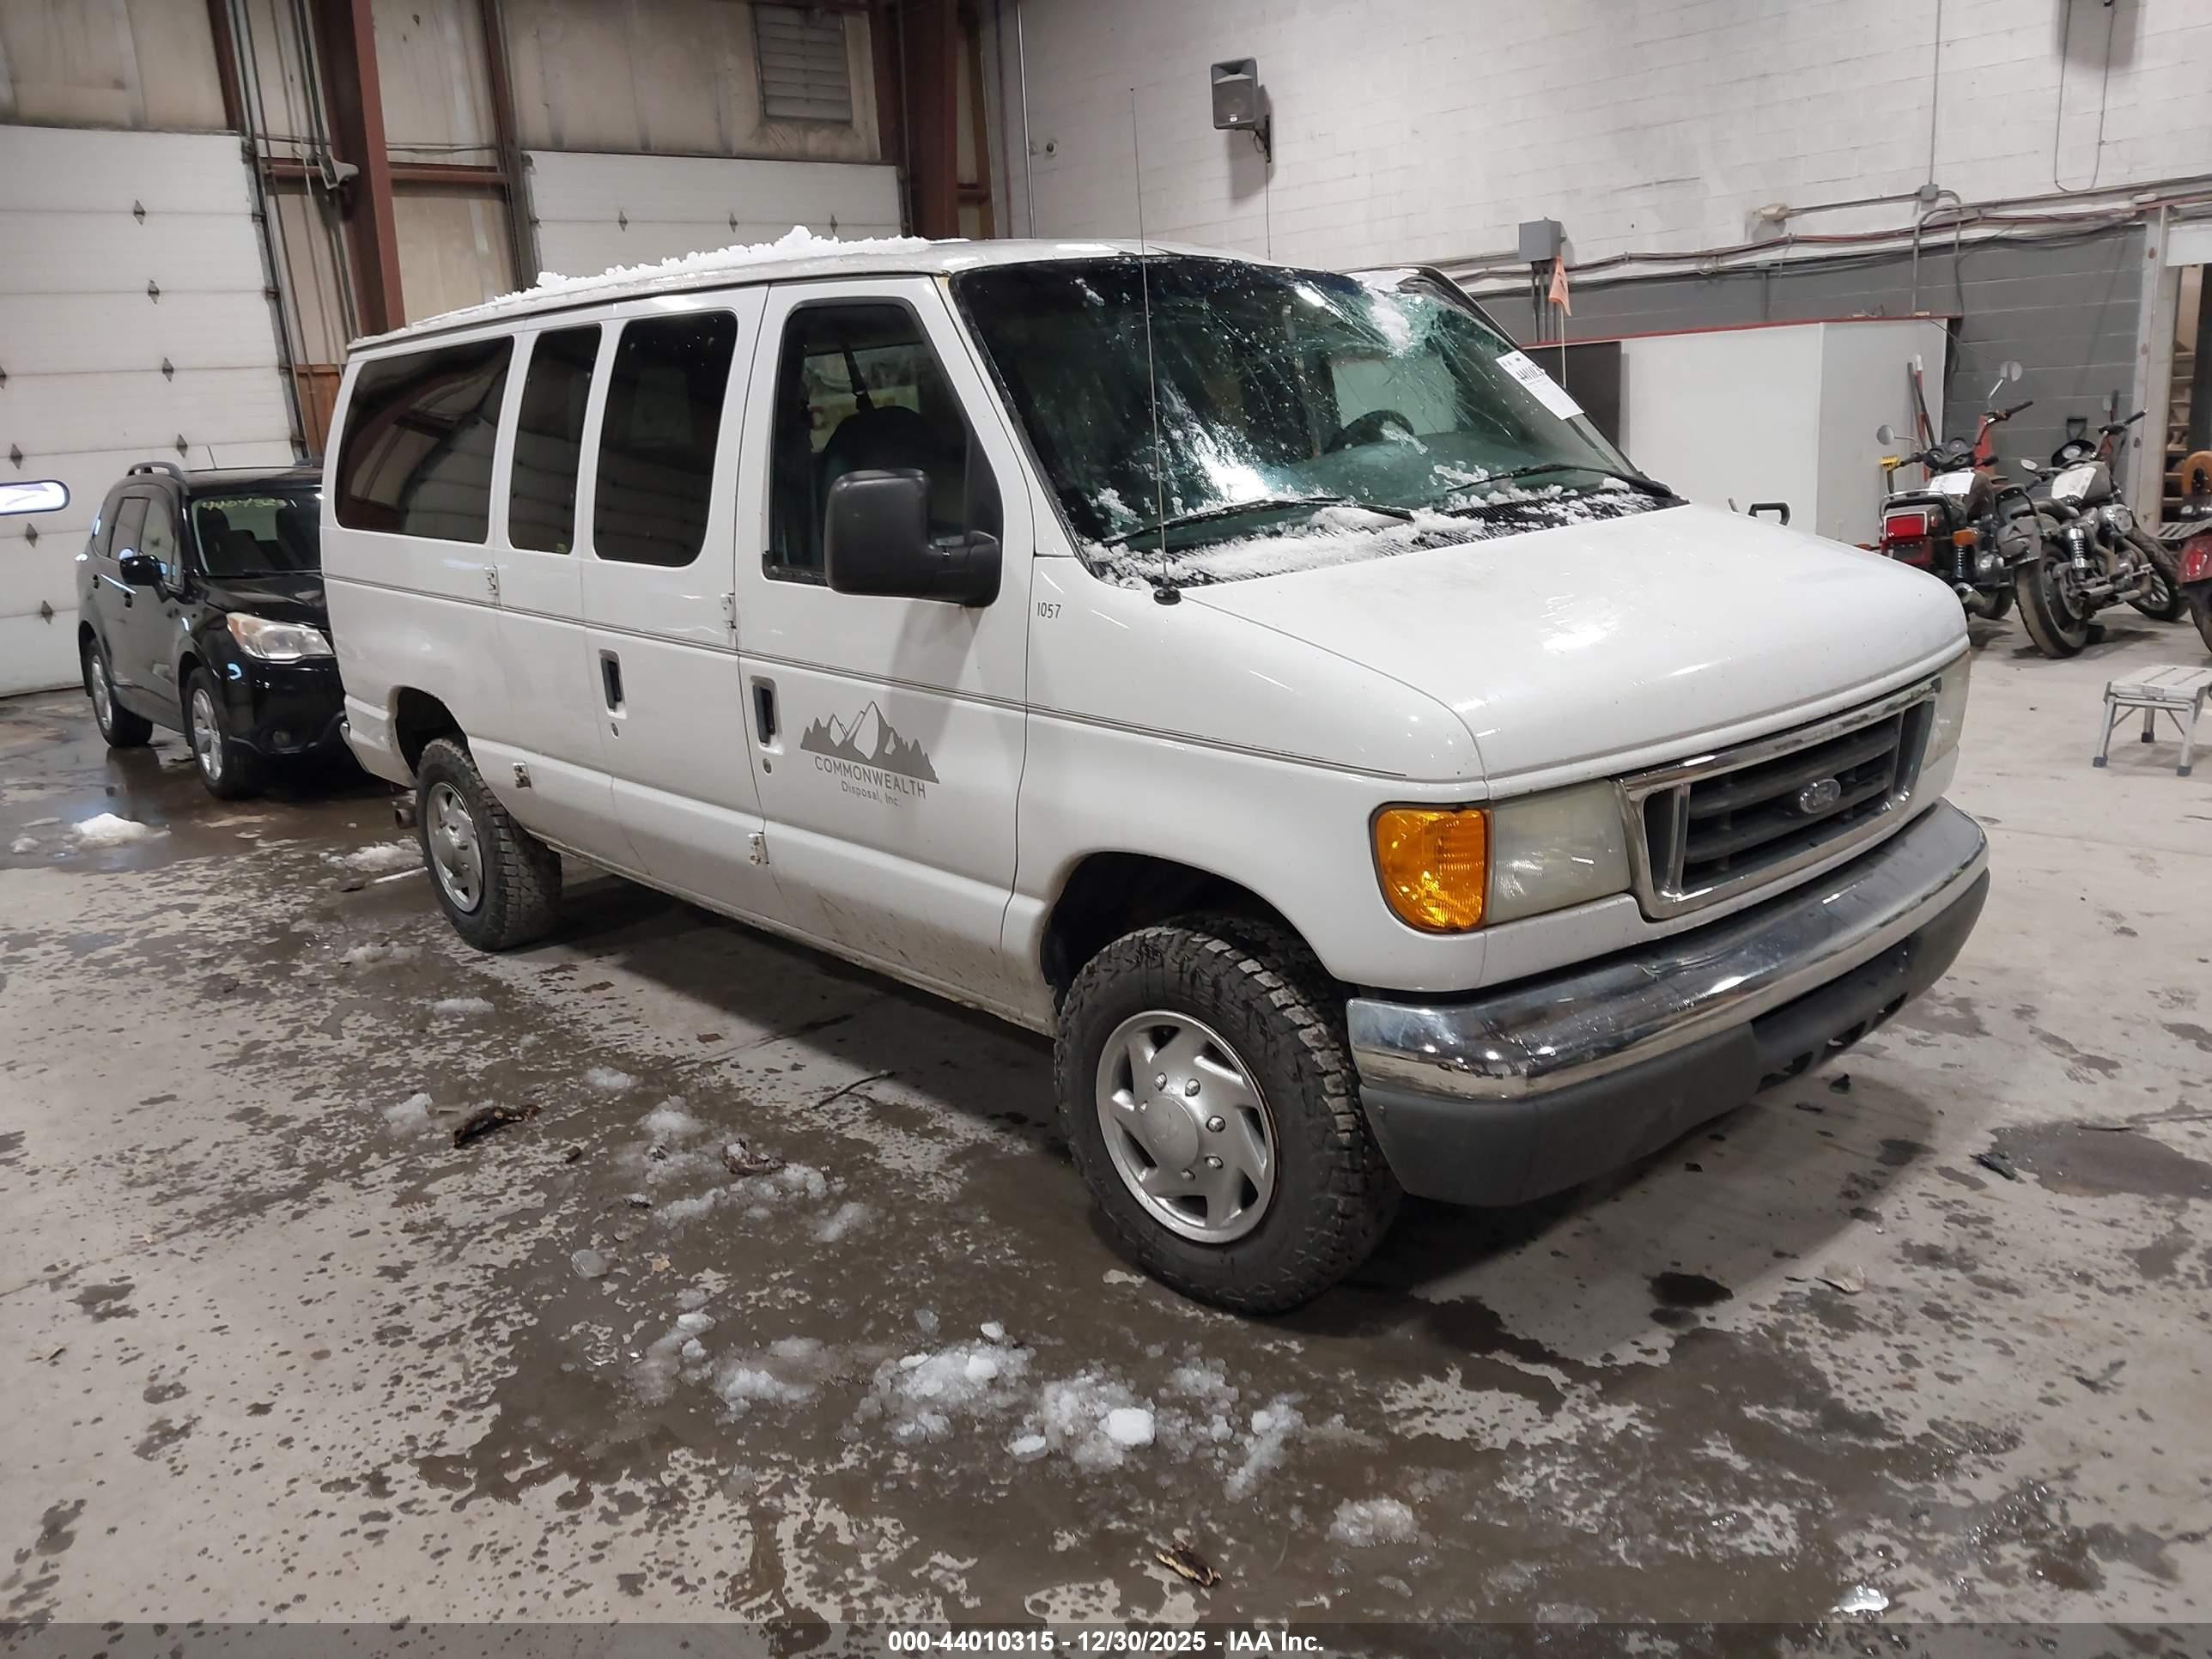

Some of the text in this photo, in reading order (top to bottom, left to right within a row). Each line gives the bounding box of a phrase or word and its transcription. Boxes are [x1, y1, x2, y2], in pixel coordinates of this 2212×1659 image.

[1037, 602, 1061, 618] 1057
[814, 756, 927, 799] COMMONWEALTH
[841, 781, 883, 804] Disposal,
